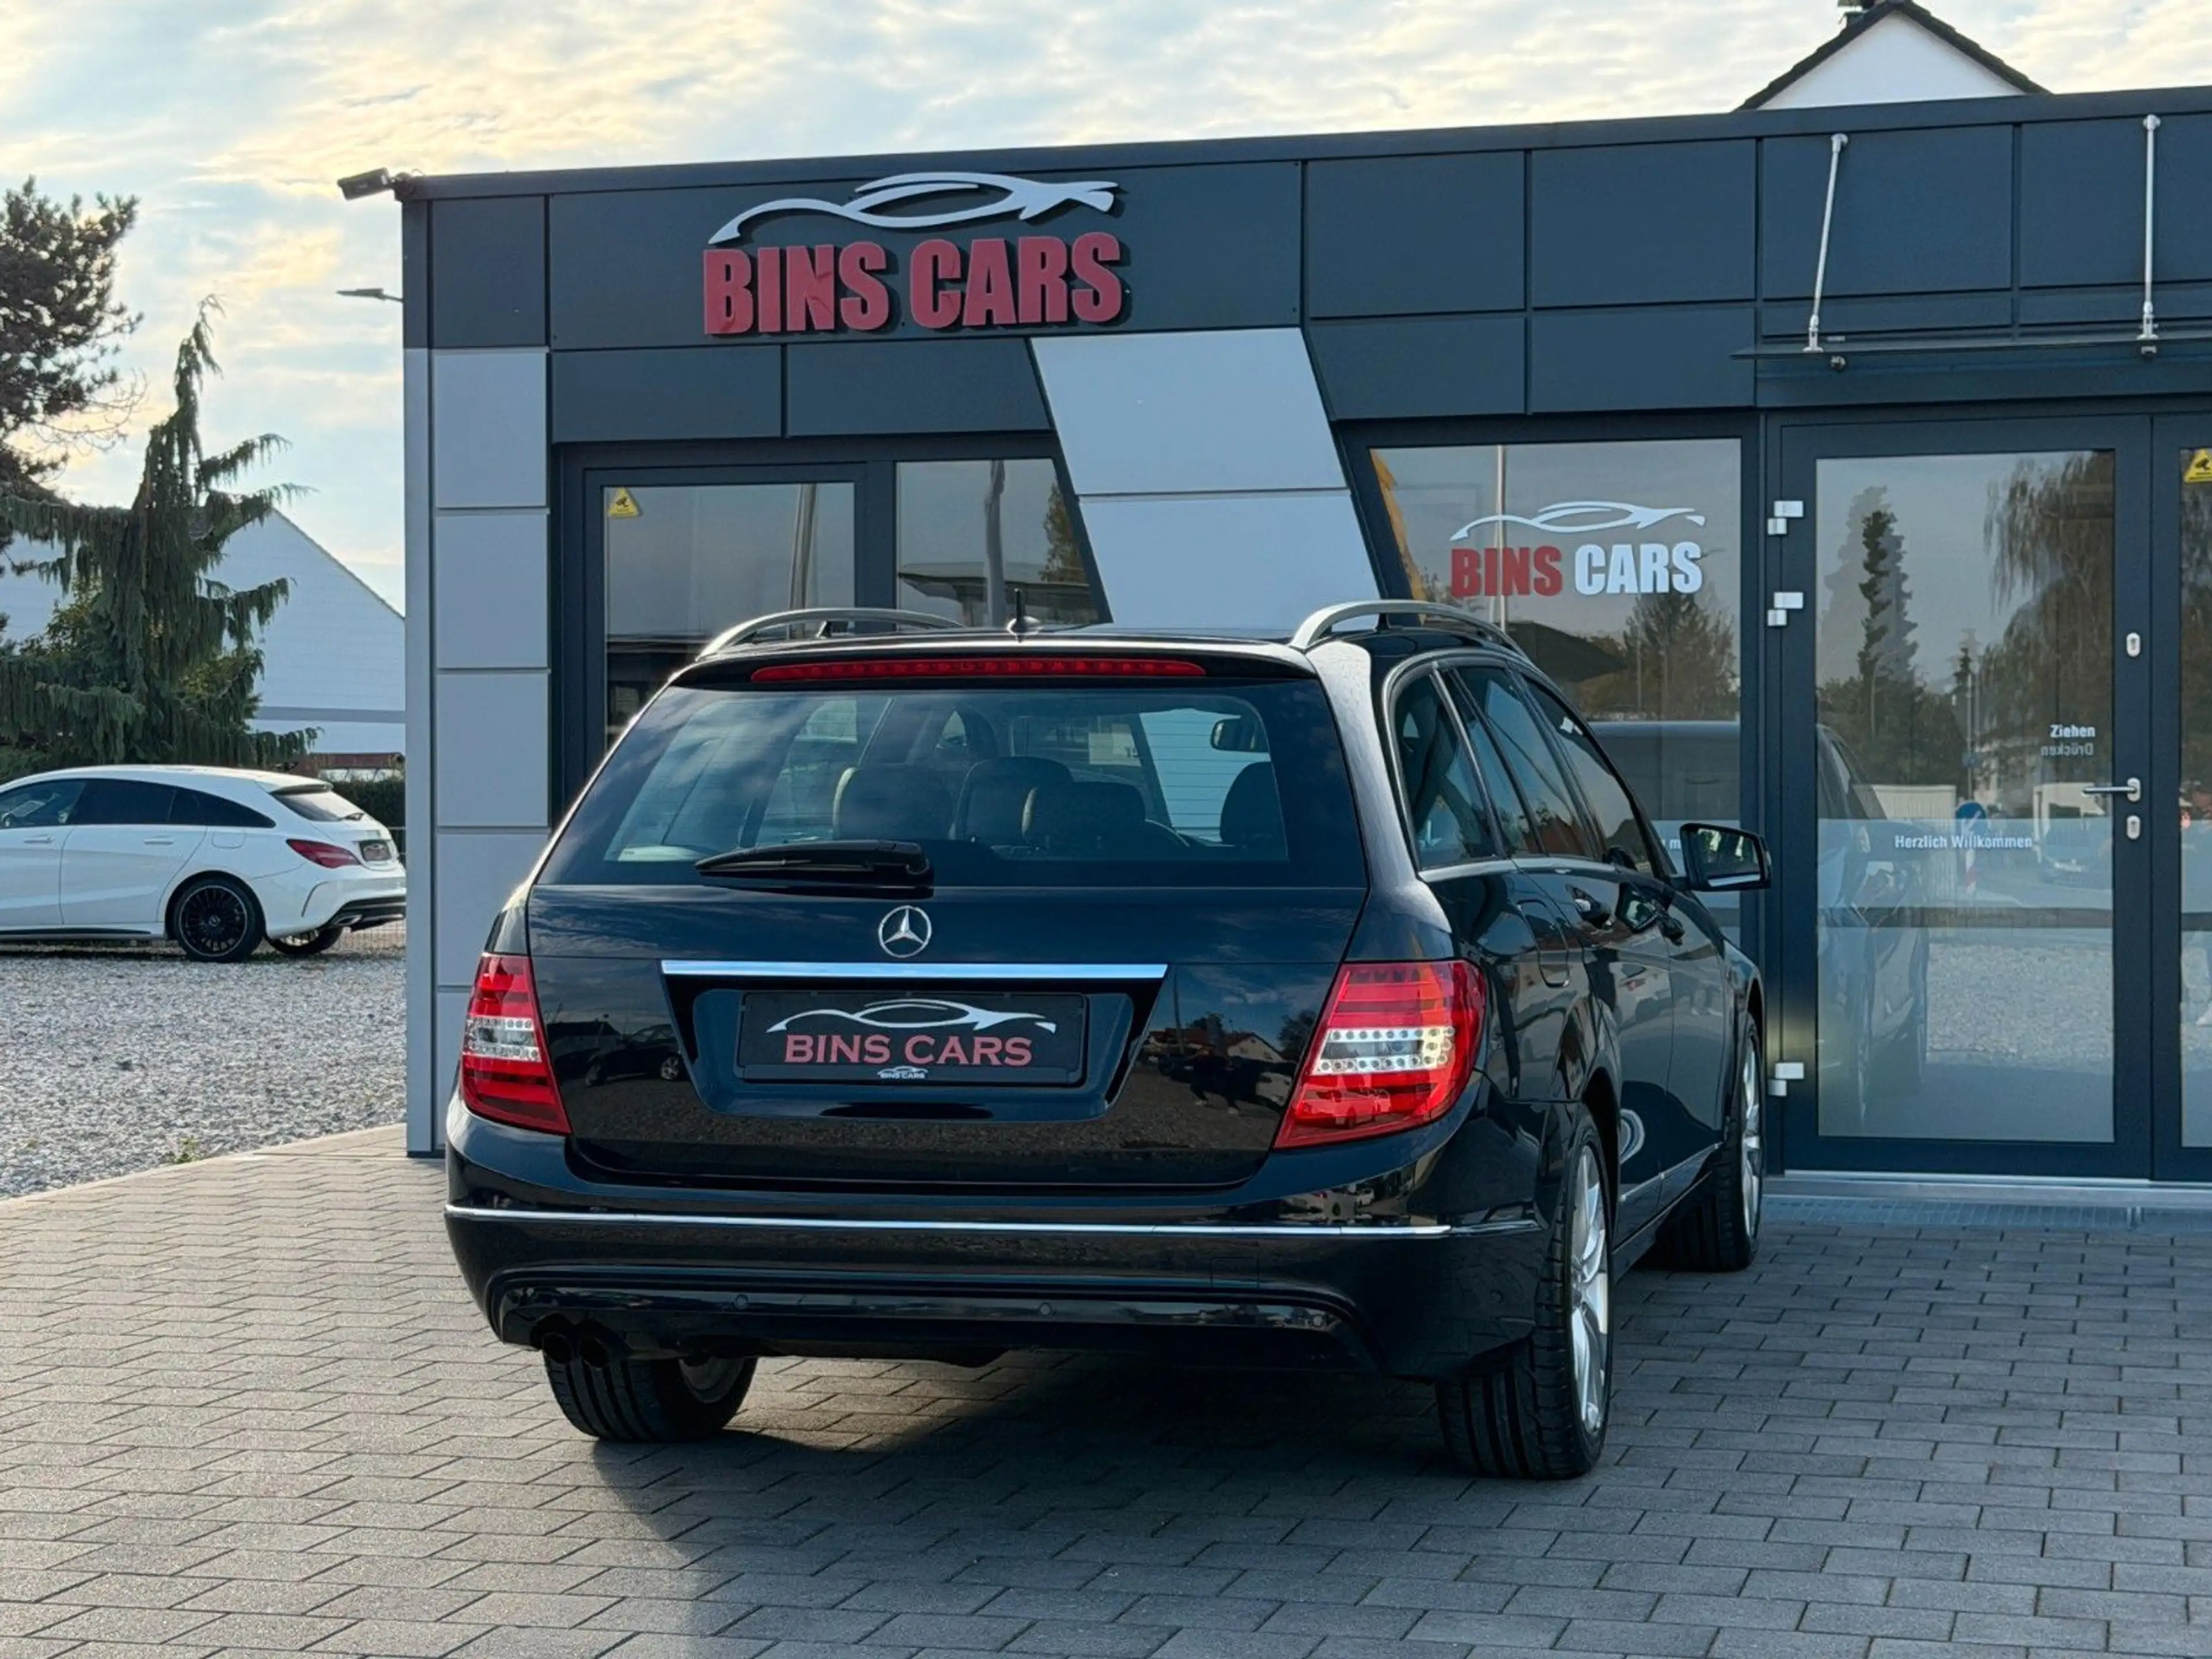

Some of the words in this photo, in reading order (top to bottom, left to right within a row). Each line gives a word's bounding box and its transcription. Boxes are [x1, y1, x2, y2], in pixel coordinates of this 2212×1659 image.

[703, 241, 889, 334] BINS
[910, 232, 1122, 329] CARS
[1450, 545, 1563, 598] BINS
[1574, 541, 1703, 595] CARS
[2050, 724, 2096, 738] Ziehen
[1895, 835, 1948, 849] Herzlich
[1951, 835, 2033, 849] Willkommen
[784, 1035, 891, 1063] BINS
[904, 1035, 1033, 1066] CARS
